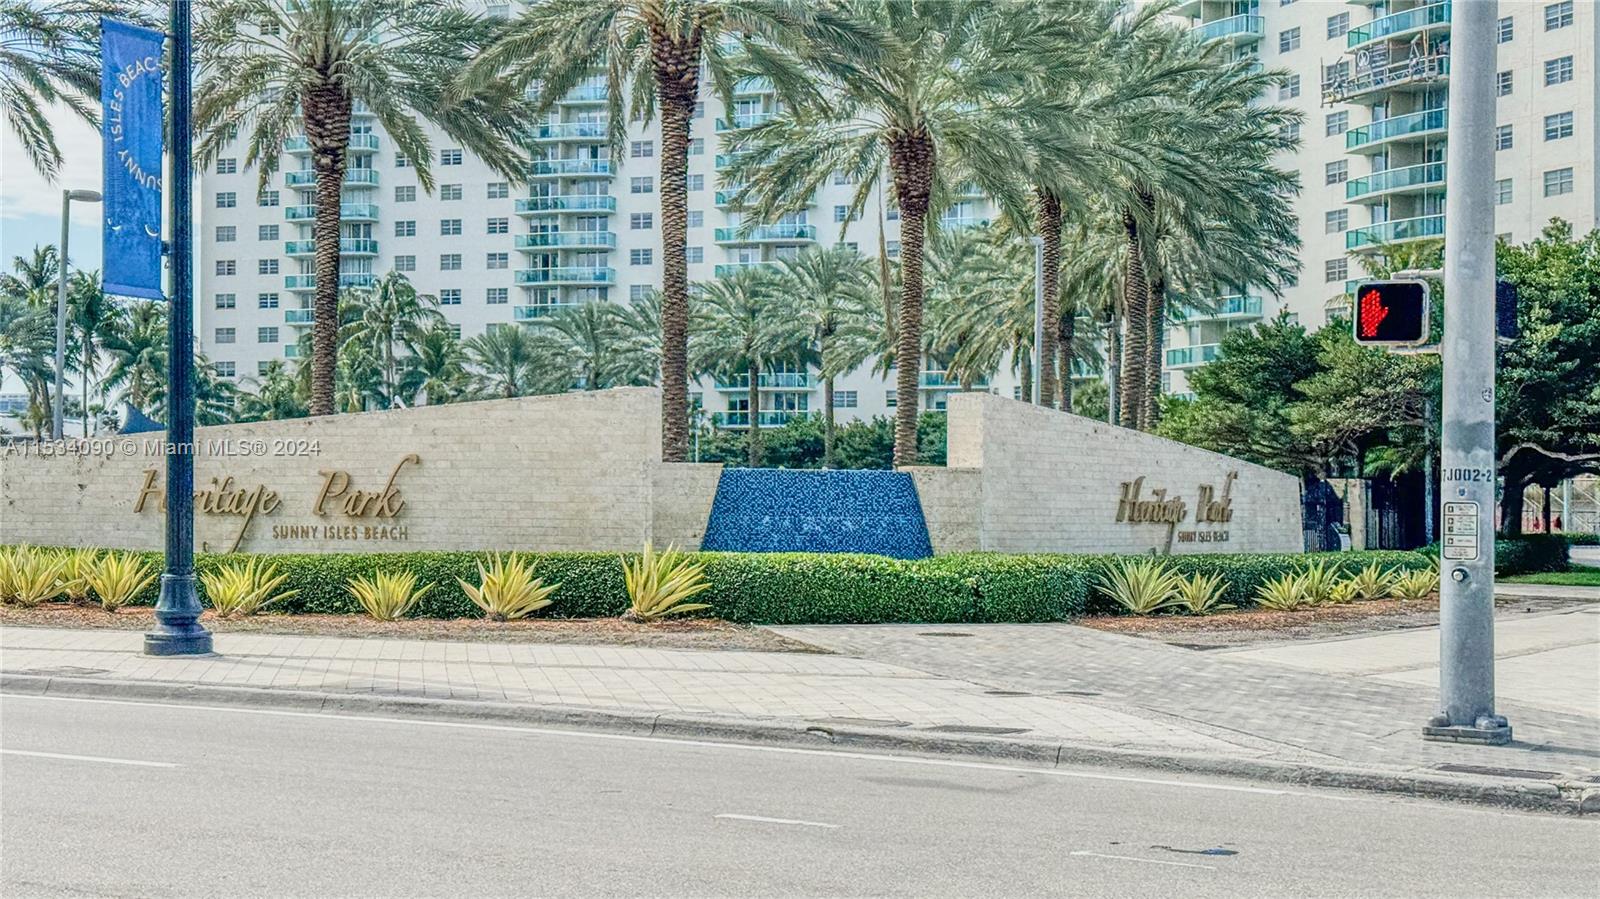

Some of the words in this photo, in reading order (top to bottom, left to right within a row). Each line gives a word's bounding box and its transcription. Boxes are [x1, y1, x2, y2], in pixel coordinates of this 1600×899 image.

[110, 88, 124, 143] ISLES
[119, 56, 162, 88] BEAC
[133, 469, 282, 553] Hritage
[313, 454, 420, 517] Park
[1196, 470, 1238, 523] Park
[272, 525, 318, 540] SUNNY
[323, 525, 358, 541] ISLES
[363, 526, 409, 540] BEACH
